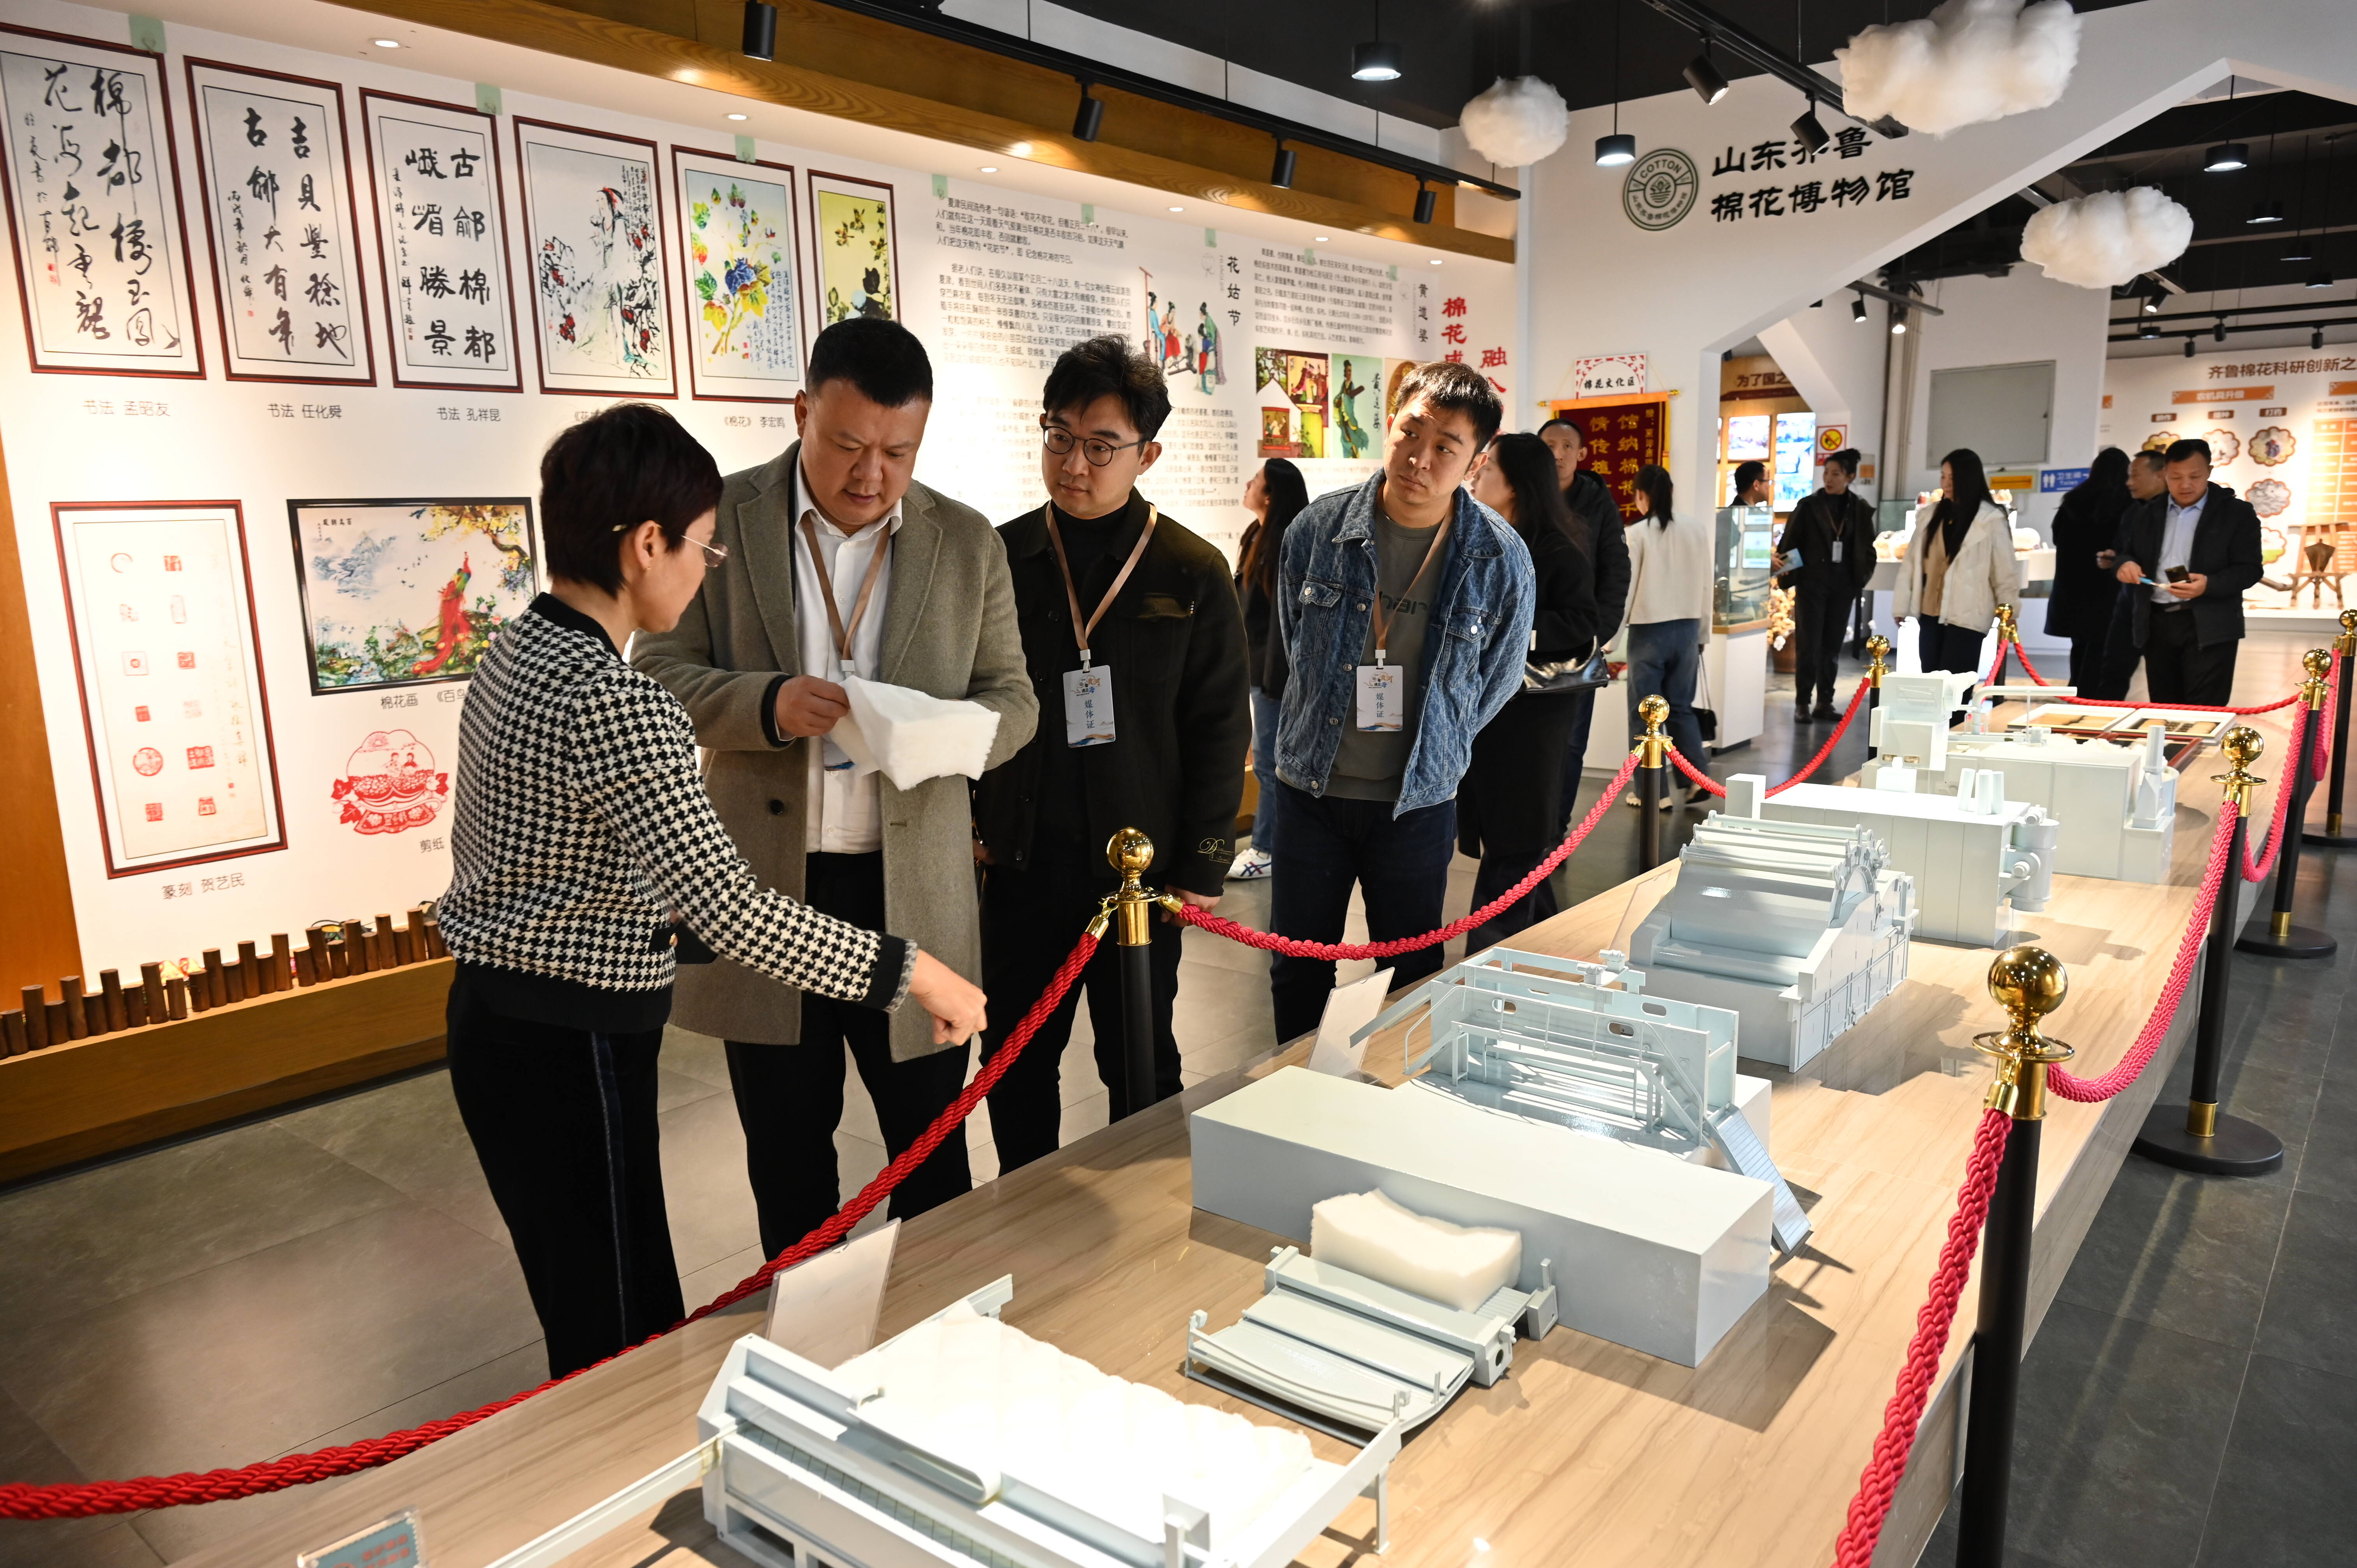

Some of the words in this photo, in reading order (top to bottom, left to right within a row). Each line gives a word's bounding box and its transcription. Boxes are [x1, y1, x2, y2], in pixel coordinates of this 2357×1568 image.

[1640, 159, 1682, 178] COTTON
[1711, 169, 1915, 222] 棉花博物馆
[1227, 256, 1240, 326] 花姑节
[2209, 357, 2357, 379] 齐鲁棉花科研创新之
[1584, 376, 1635, 389] 棉花文化区
[82, 399, 115, 415] 书法
[124, 401, 171, 416] 孟昭友
[267, 403, 295, 418] 书法
[302, 404, 343, 419] 任化舜
[437, 407, 461, 420] 书法
[466, 408, 501, 422] 孔祥昆
[381, 693, 418, 710] 棉花画
[1376, 693, 1384, 718] 媒体证
[1084, 699, 1095, 729] 媒体证
[419, 837, 445, 853] 剪纸
[162, 881, 193, 900] 篆刻
[201, 872, 245, 893] 贺艺民
